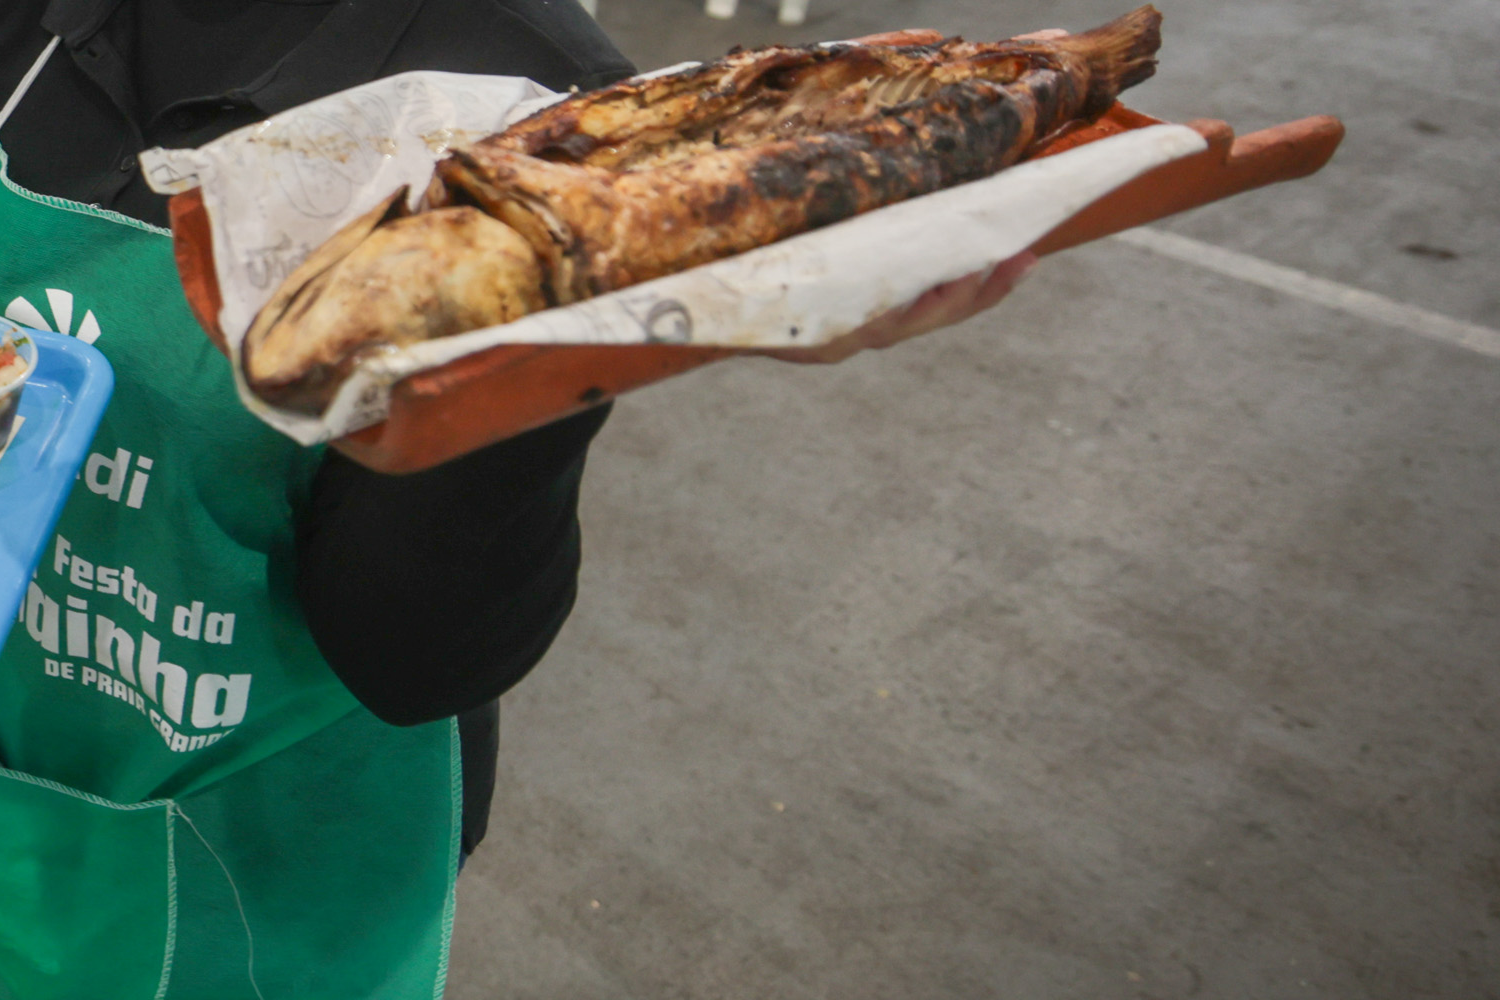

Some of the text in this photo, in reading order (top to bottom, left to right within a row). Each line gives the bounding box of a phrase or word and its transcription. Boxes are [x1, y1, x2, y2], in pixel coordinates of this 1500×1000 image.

[76, 447, 154, 510] di
[53, 534, 236, 645] Festa da
[18, 580, 252, 729] ainha
[45, 658, 75, 680] DE
[81, 665, 146, 715] PRAIA
